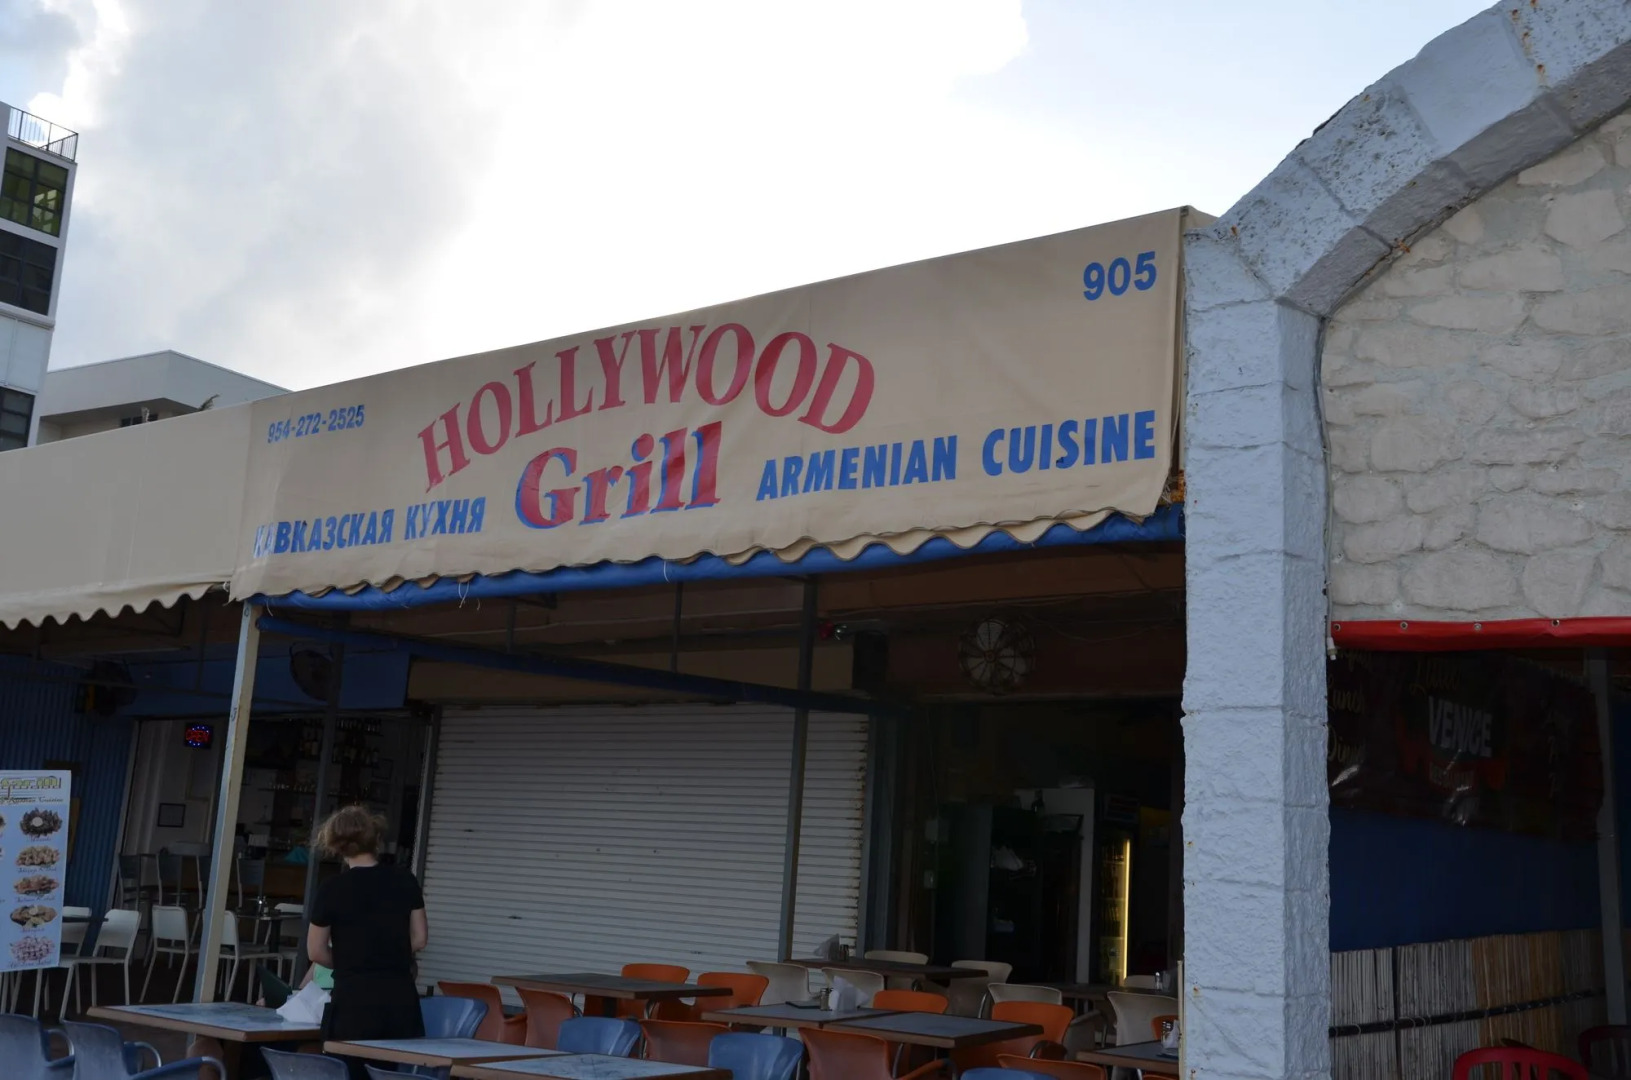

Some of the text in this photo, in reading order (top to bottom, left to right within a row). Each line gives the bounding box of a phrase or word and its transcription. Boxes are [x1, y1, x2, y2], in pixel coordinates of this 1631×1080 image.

[1083, 251, 1157, 301] 905
[267, 404, 365, 444] 954-272-2525
[417, 322, 875, 494] HOLLYWOOD
[514, 421, 723, 529] Grill
[755, 410, 1156, 502] ARMENIAN CUISINE
[253, 497, 486, 559] КАВКАЗСКАЯ КУХНЯ
[1427, 695, 1494, 758] VENICE
